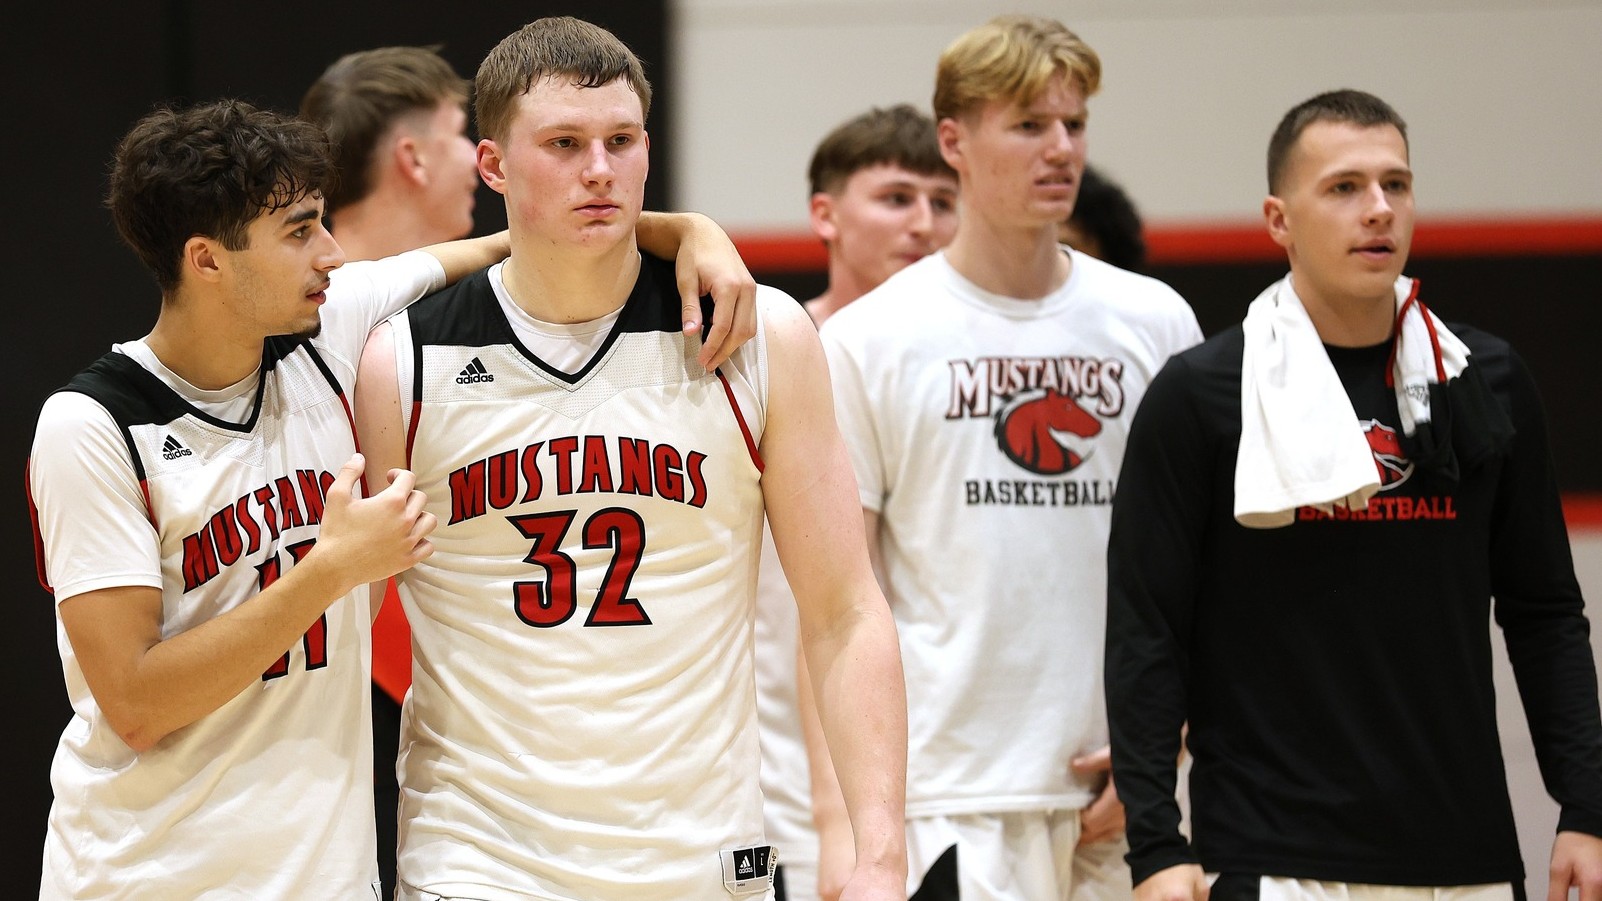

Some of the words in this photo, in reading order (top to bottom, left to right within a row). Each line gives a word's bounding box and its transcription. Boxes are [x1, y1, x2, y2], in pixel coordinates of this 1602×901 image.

[456, 373, 494, 384] adidas
[945, 356, 1124, 420] MUSTANGS
[163, 448, 192, 461] adidas
[448, 435, 708, 526] MUSTANGS
[505, 507, 653, 628] 32
